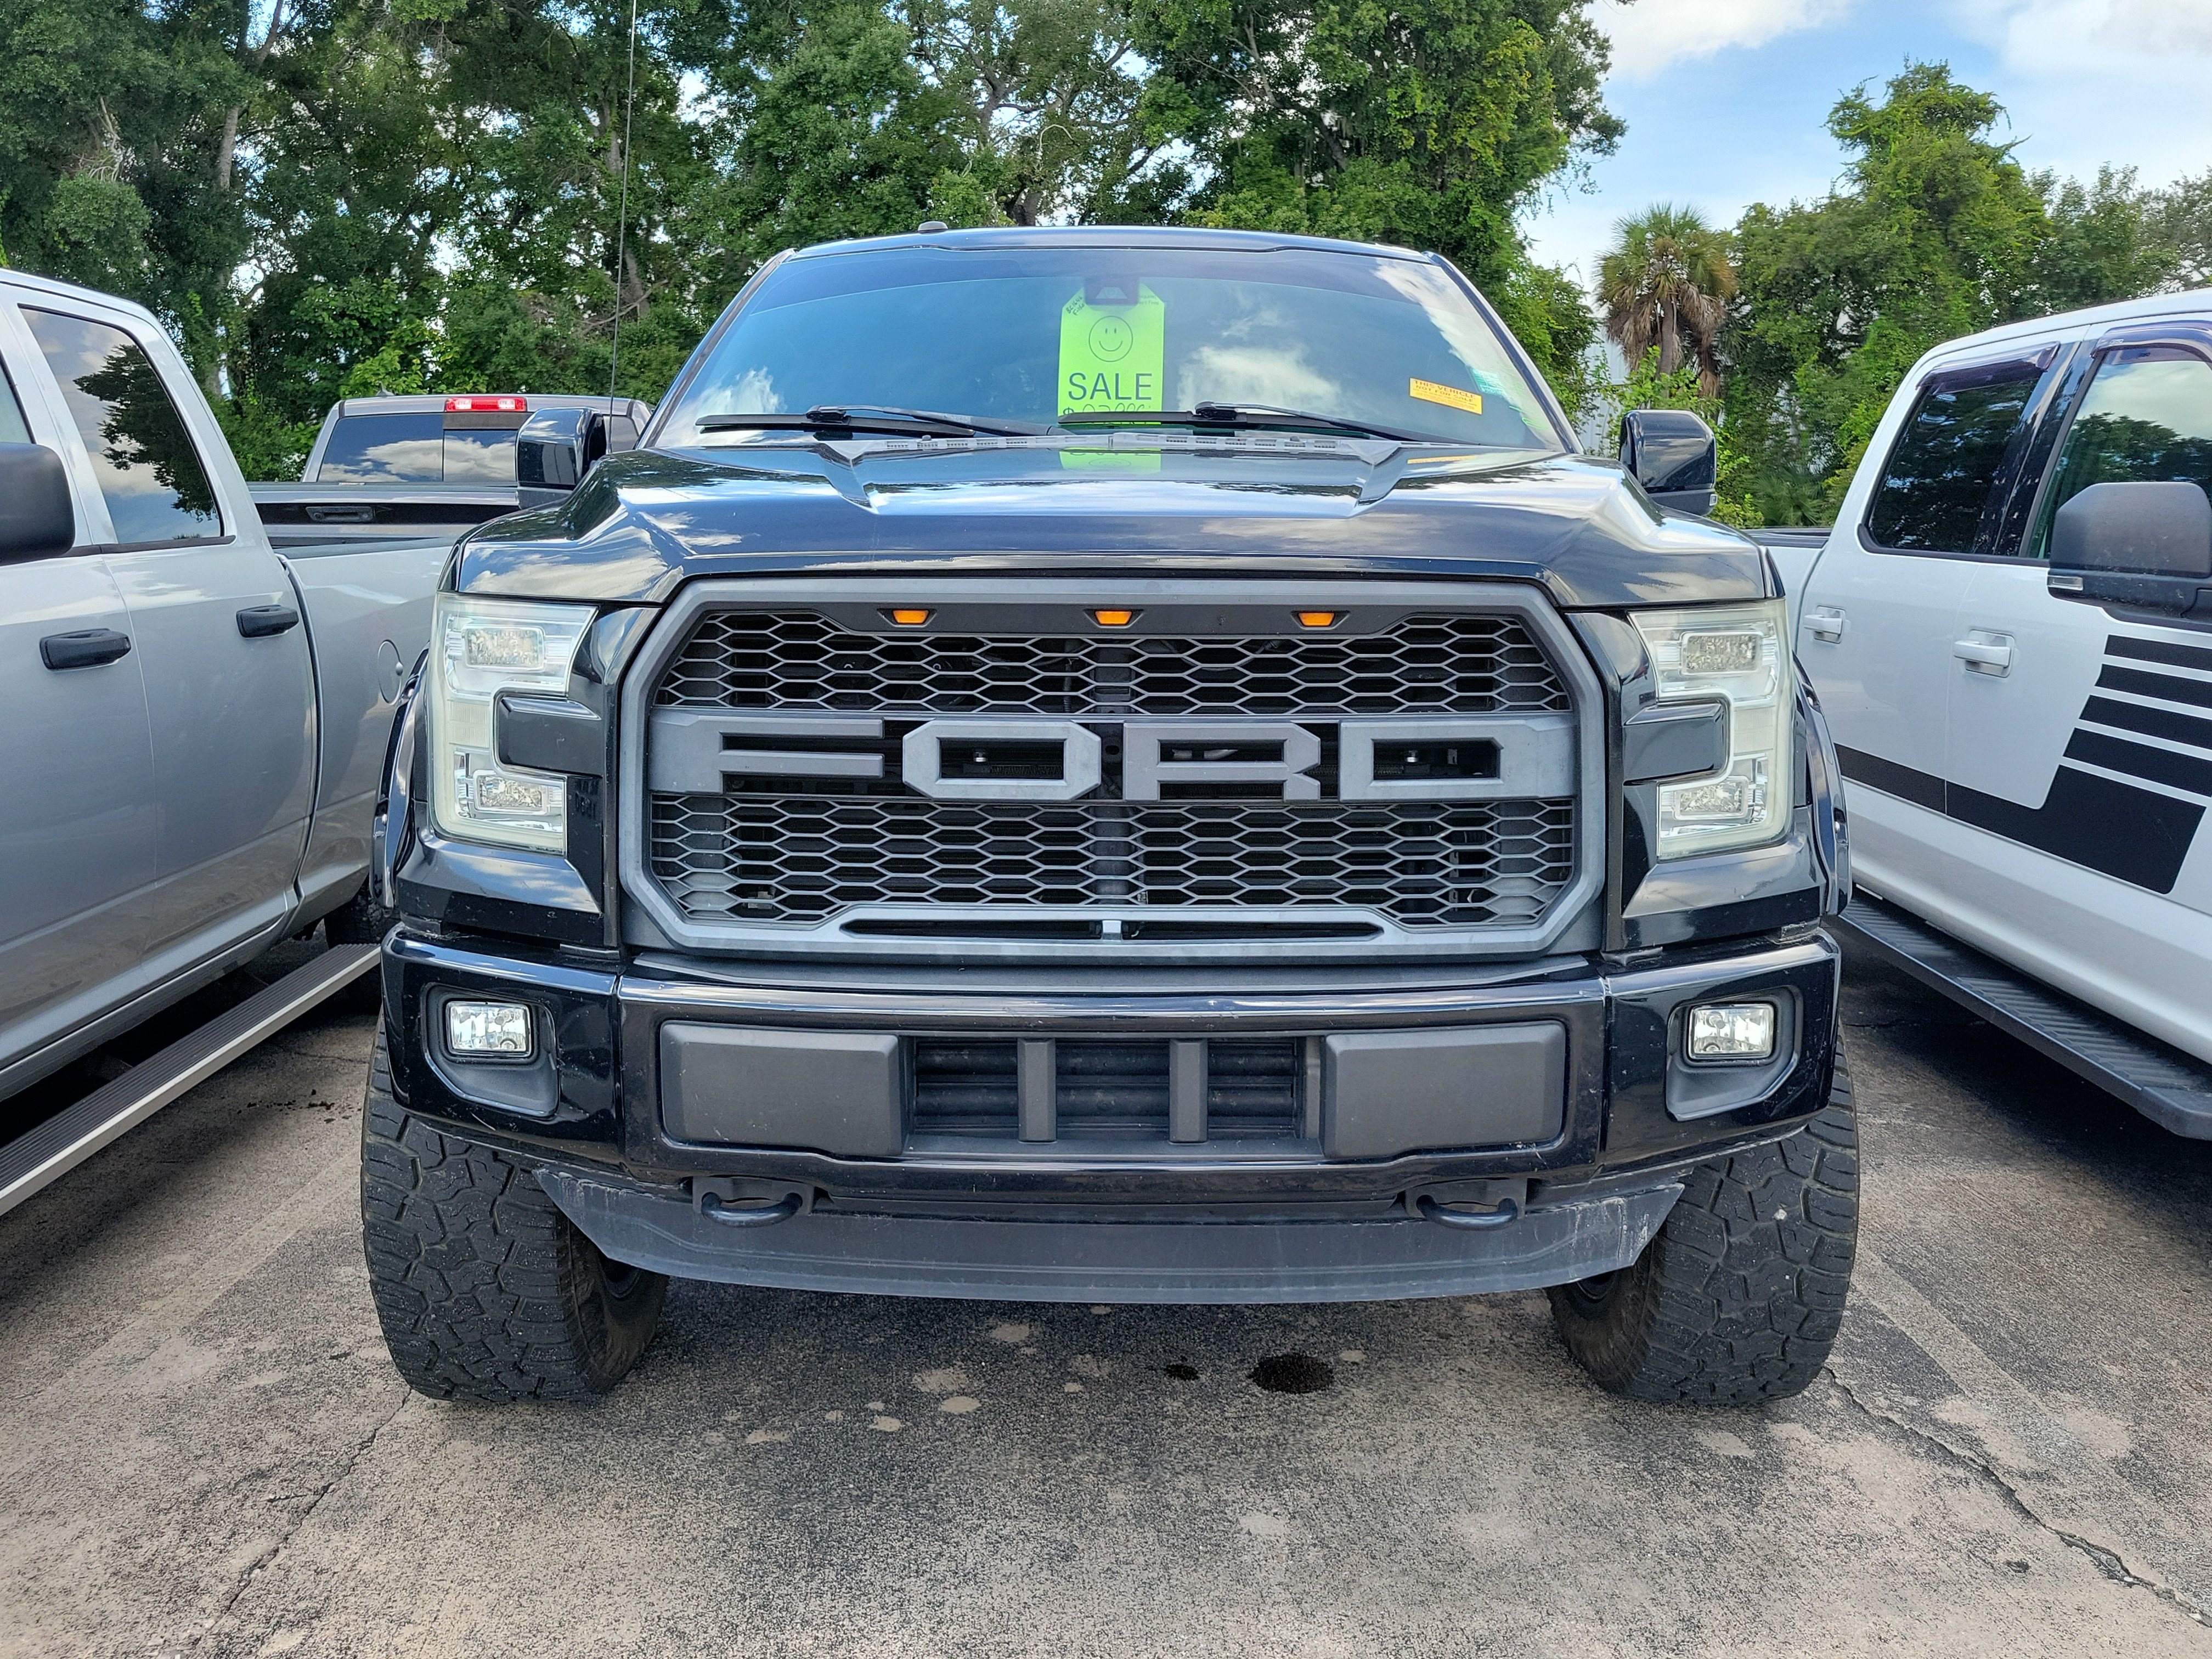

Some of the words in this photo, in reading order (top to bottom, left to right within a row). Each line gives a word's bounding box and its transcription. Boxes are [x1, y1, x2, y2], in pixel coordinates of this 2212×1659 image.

[1068, 373, 1153, 400] SALE
[1414, 380, 1435, 388] THIS
[1437, 385, 1476, 399] VEHICLE
[1453, 394, 1474, 402] SALE
[649, 714, 1575, 803] FORD
